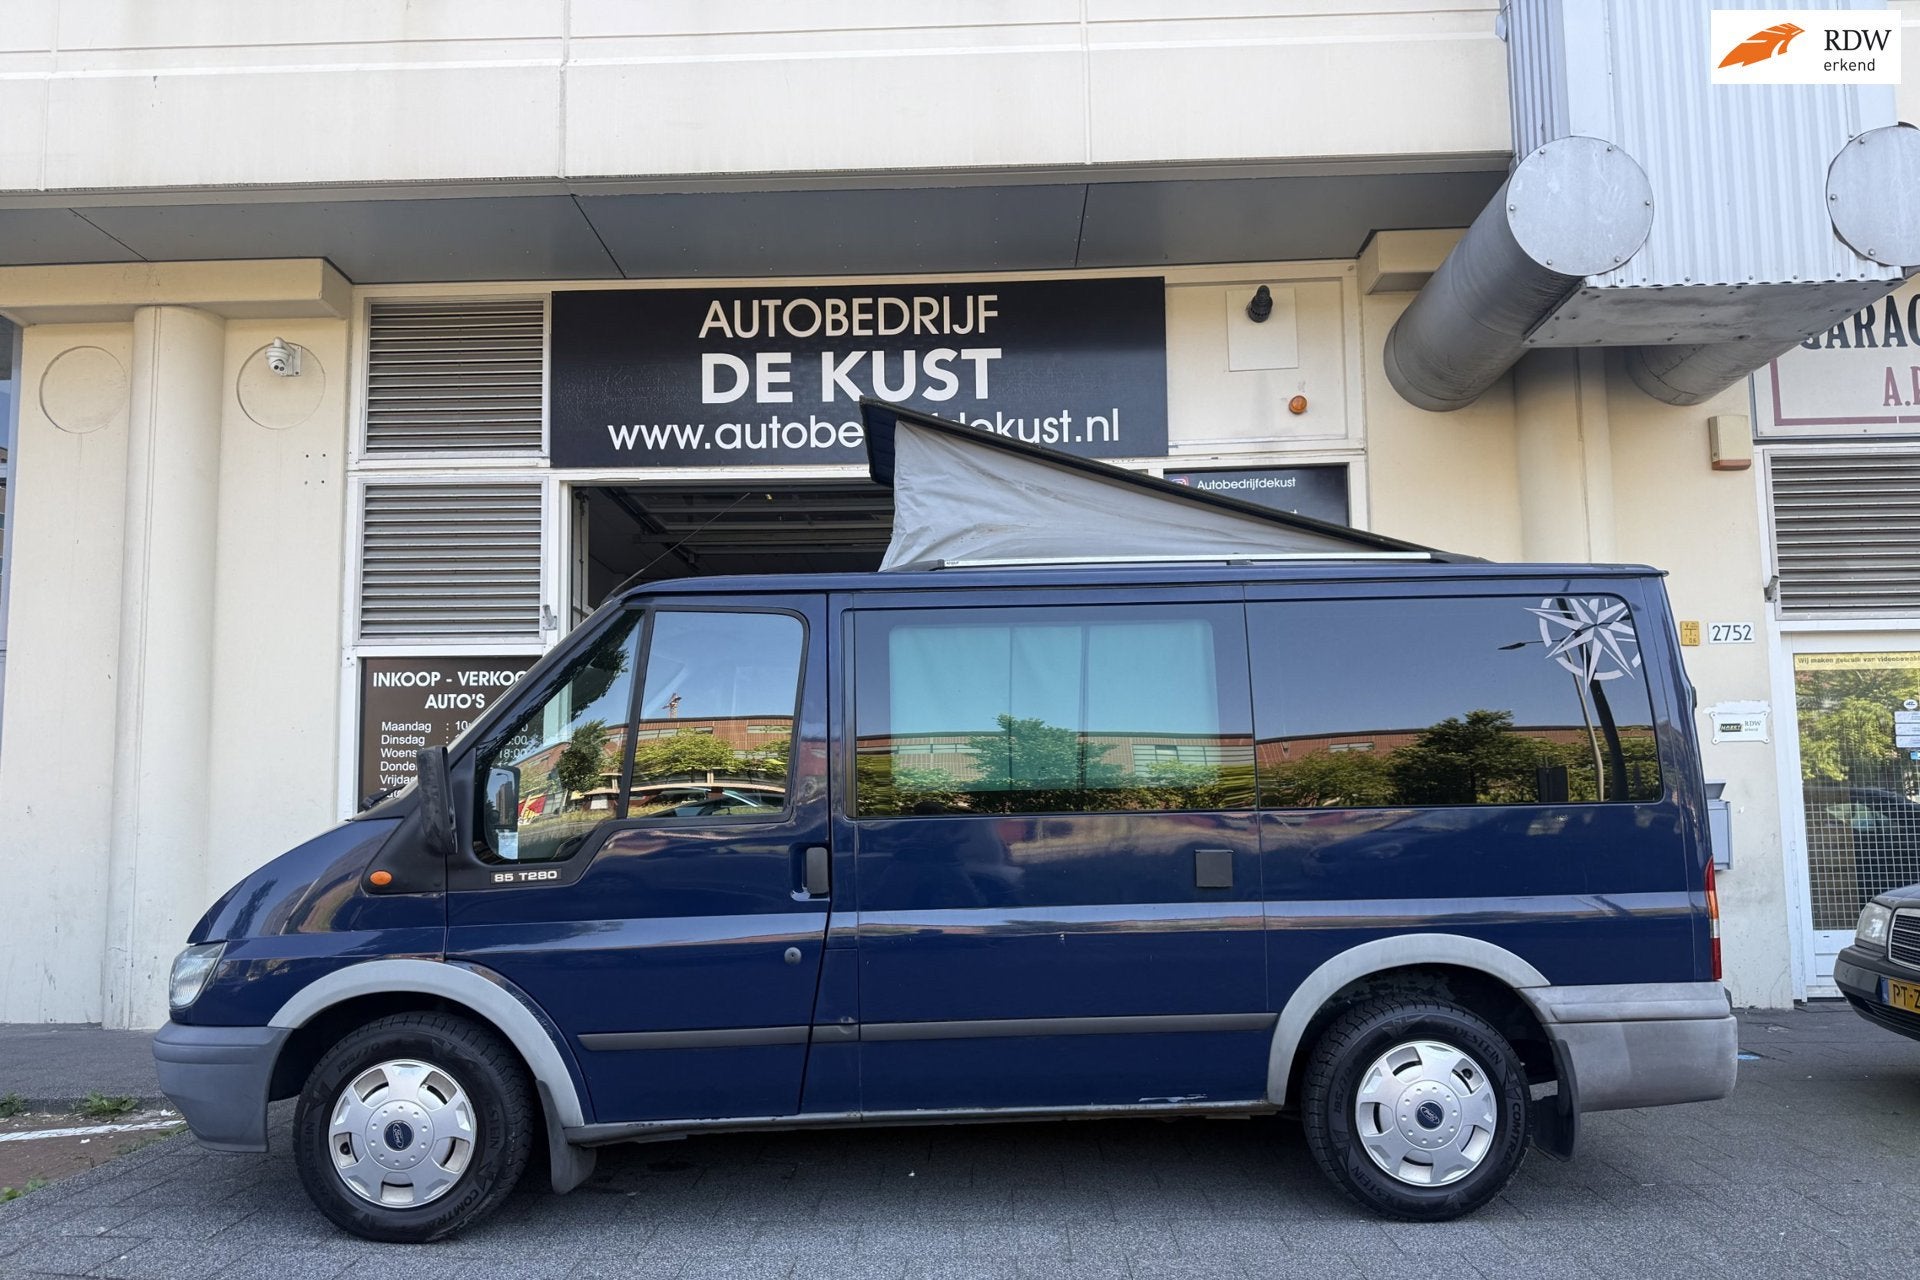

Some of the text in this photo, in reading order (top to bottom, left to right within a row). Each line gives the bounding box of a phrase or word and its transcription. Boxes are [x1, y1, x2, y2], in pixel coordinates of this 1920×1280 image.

[698, 294, 999, 338] AUTOBEDRIJF
[1800, 291, 1920, 350] ARA
[702, 348, 1002, 404] DE KUST
[1197, 477, 1297, 491] Autobedrijfdekust
[1712, 625, 1752, 641] 2752
[373, 672, 441, 687] INKOOP
[424, 694, 486, 709] AUTO'S
[382, 721, 432, 733] Maandag
[381, 735, 426, 746] Dinsdag
[380, 747, 418, 758] Woens
[380, 761, 417, 771] Donde
[495, 870, 558, 882] 85 T280
